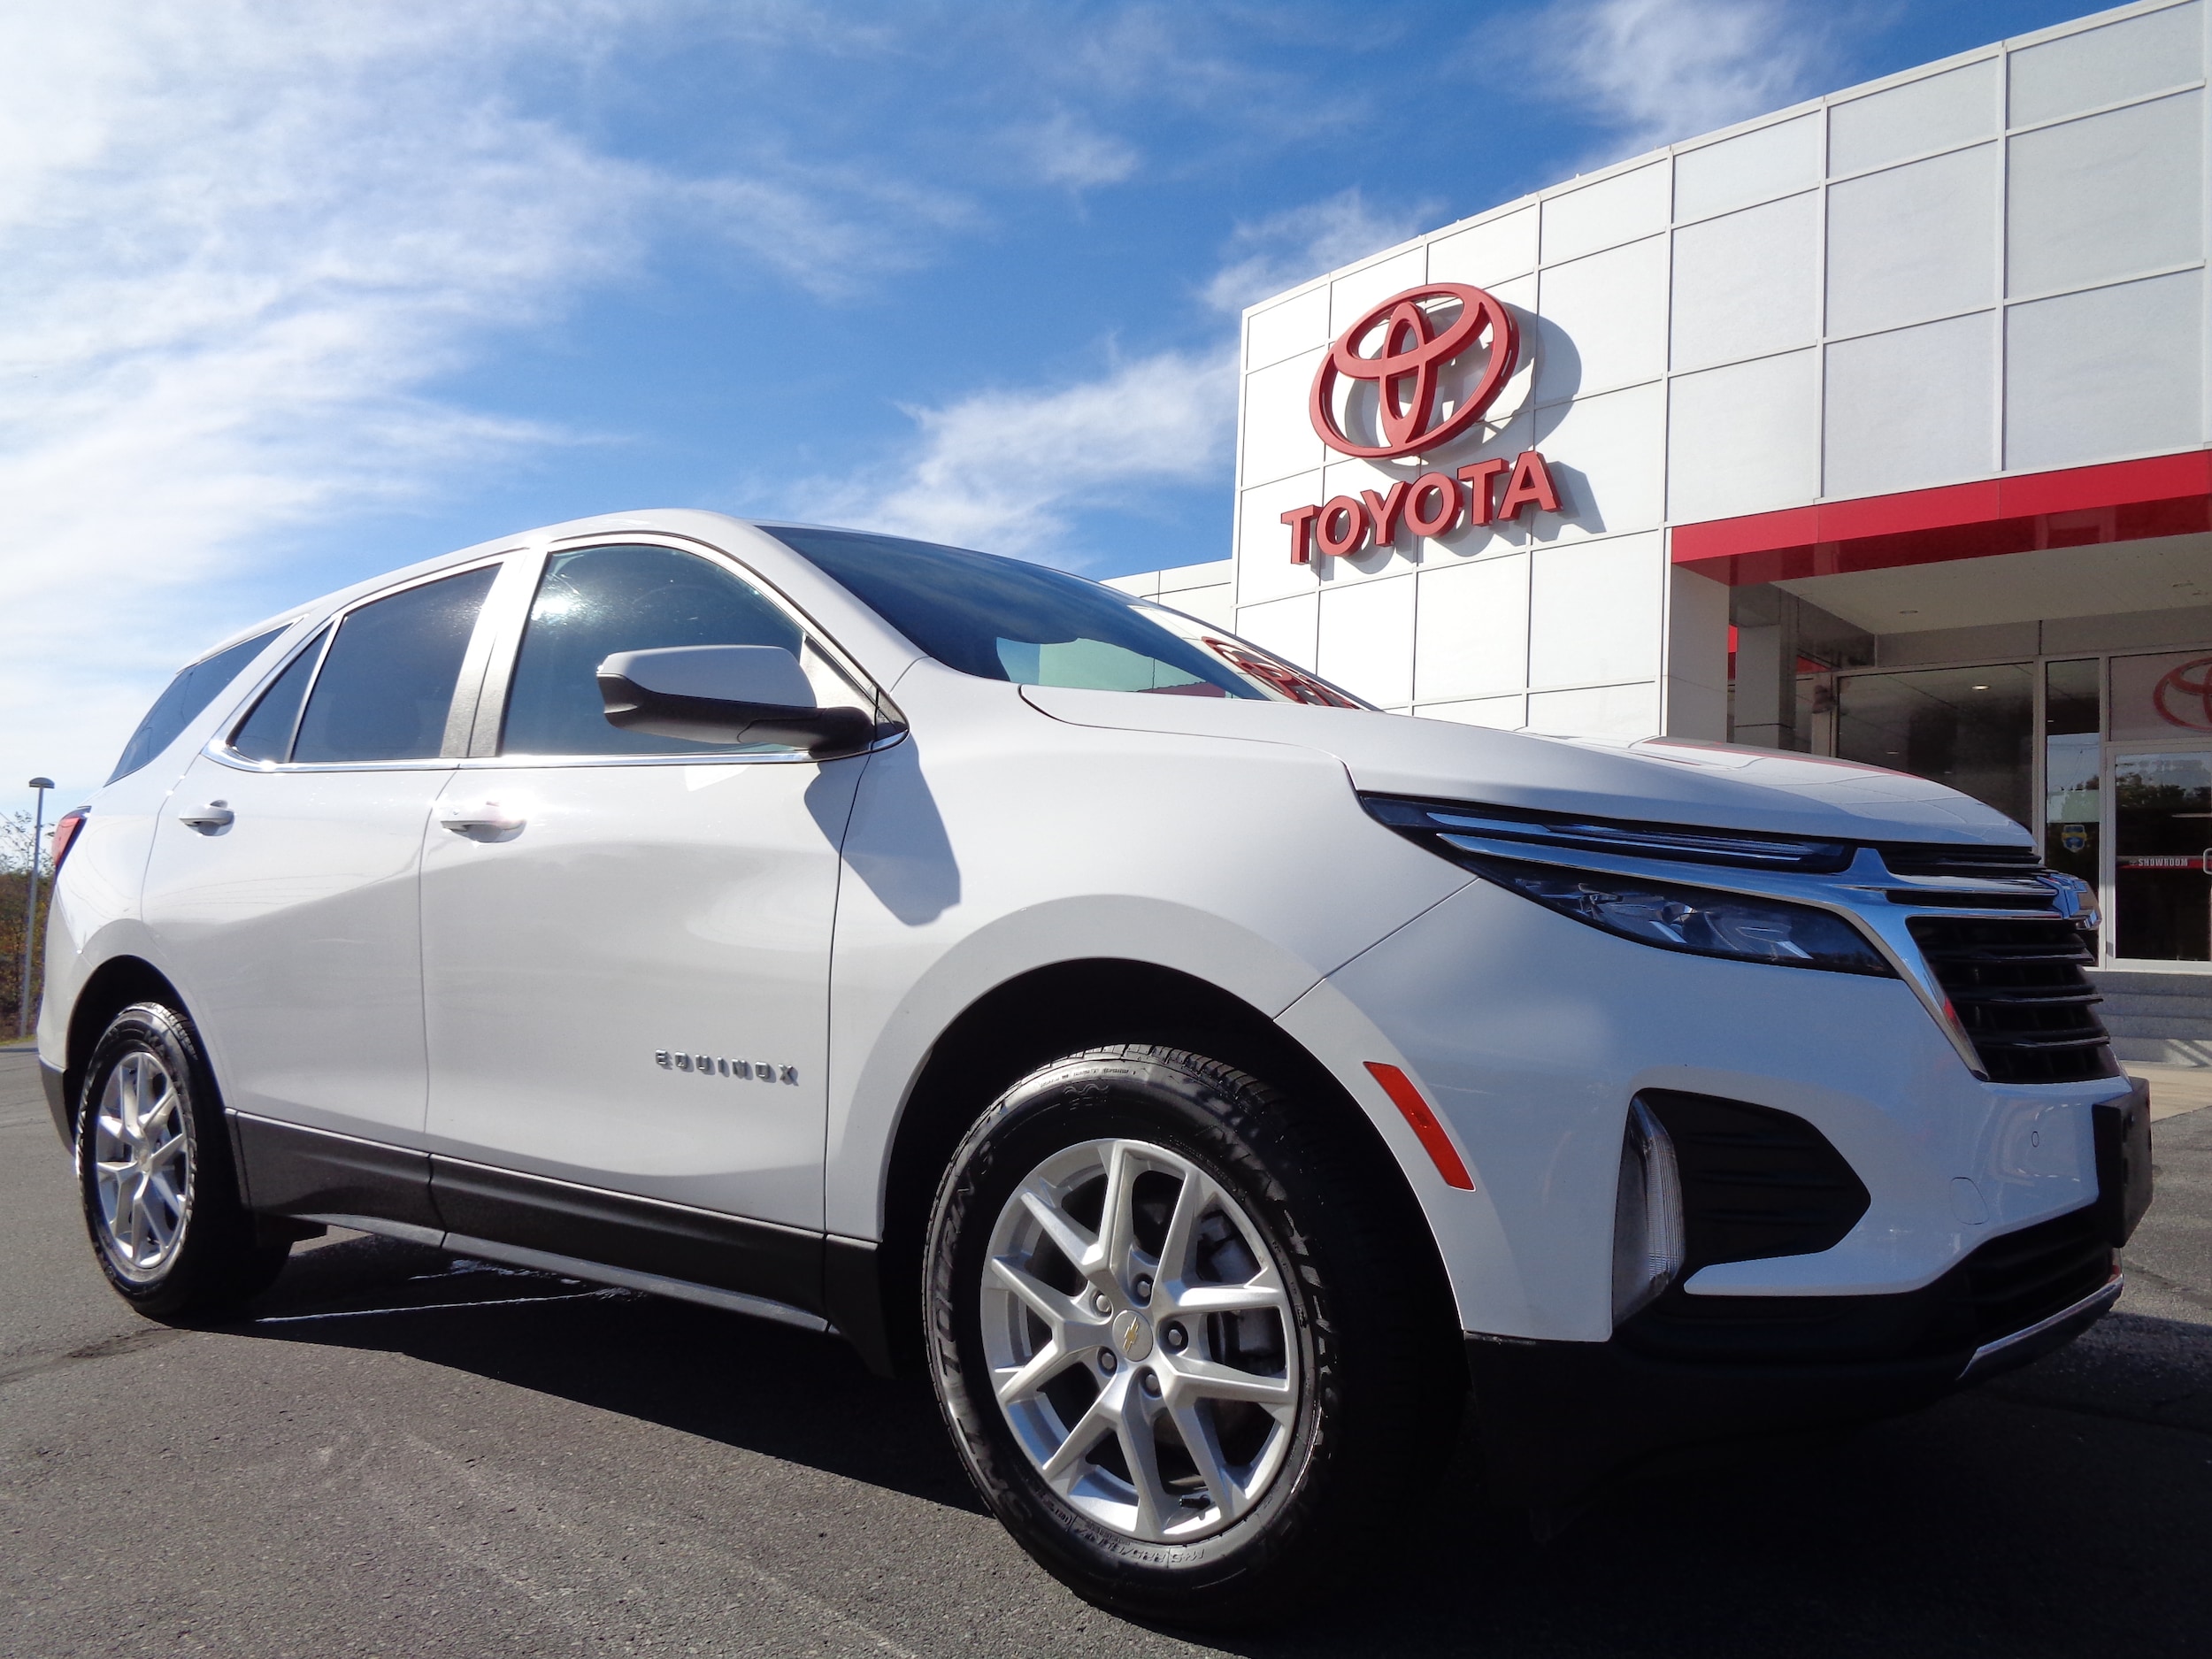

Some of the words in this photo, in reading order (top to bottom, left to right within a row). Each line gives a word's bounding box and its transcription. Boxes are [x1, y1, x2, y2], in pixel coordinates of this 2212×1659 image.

[1280, 450, 1563, 565] TOYOTA
[2138, 857, 2188, 867] SHOWROOM
[655, 1048, 797, 1085] EQUINOX
[935, 1139, 994, 1379] TOURING
